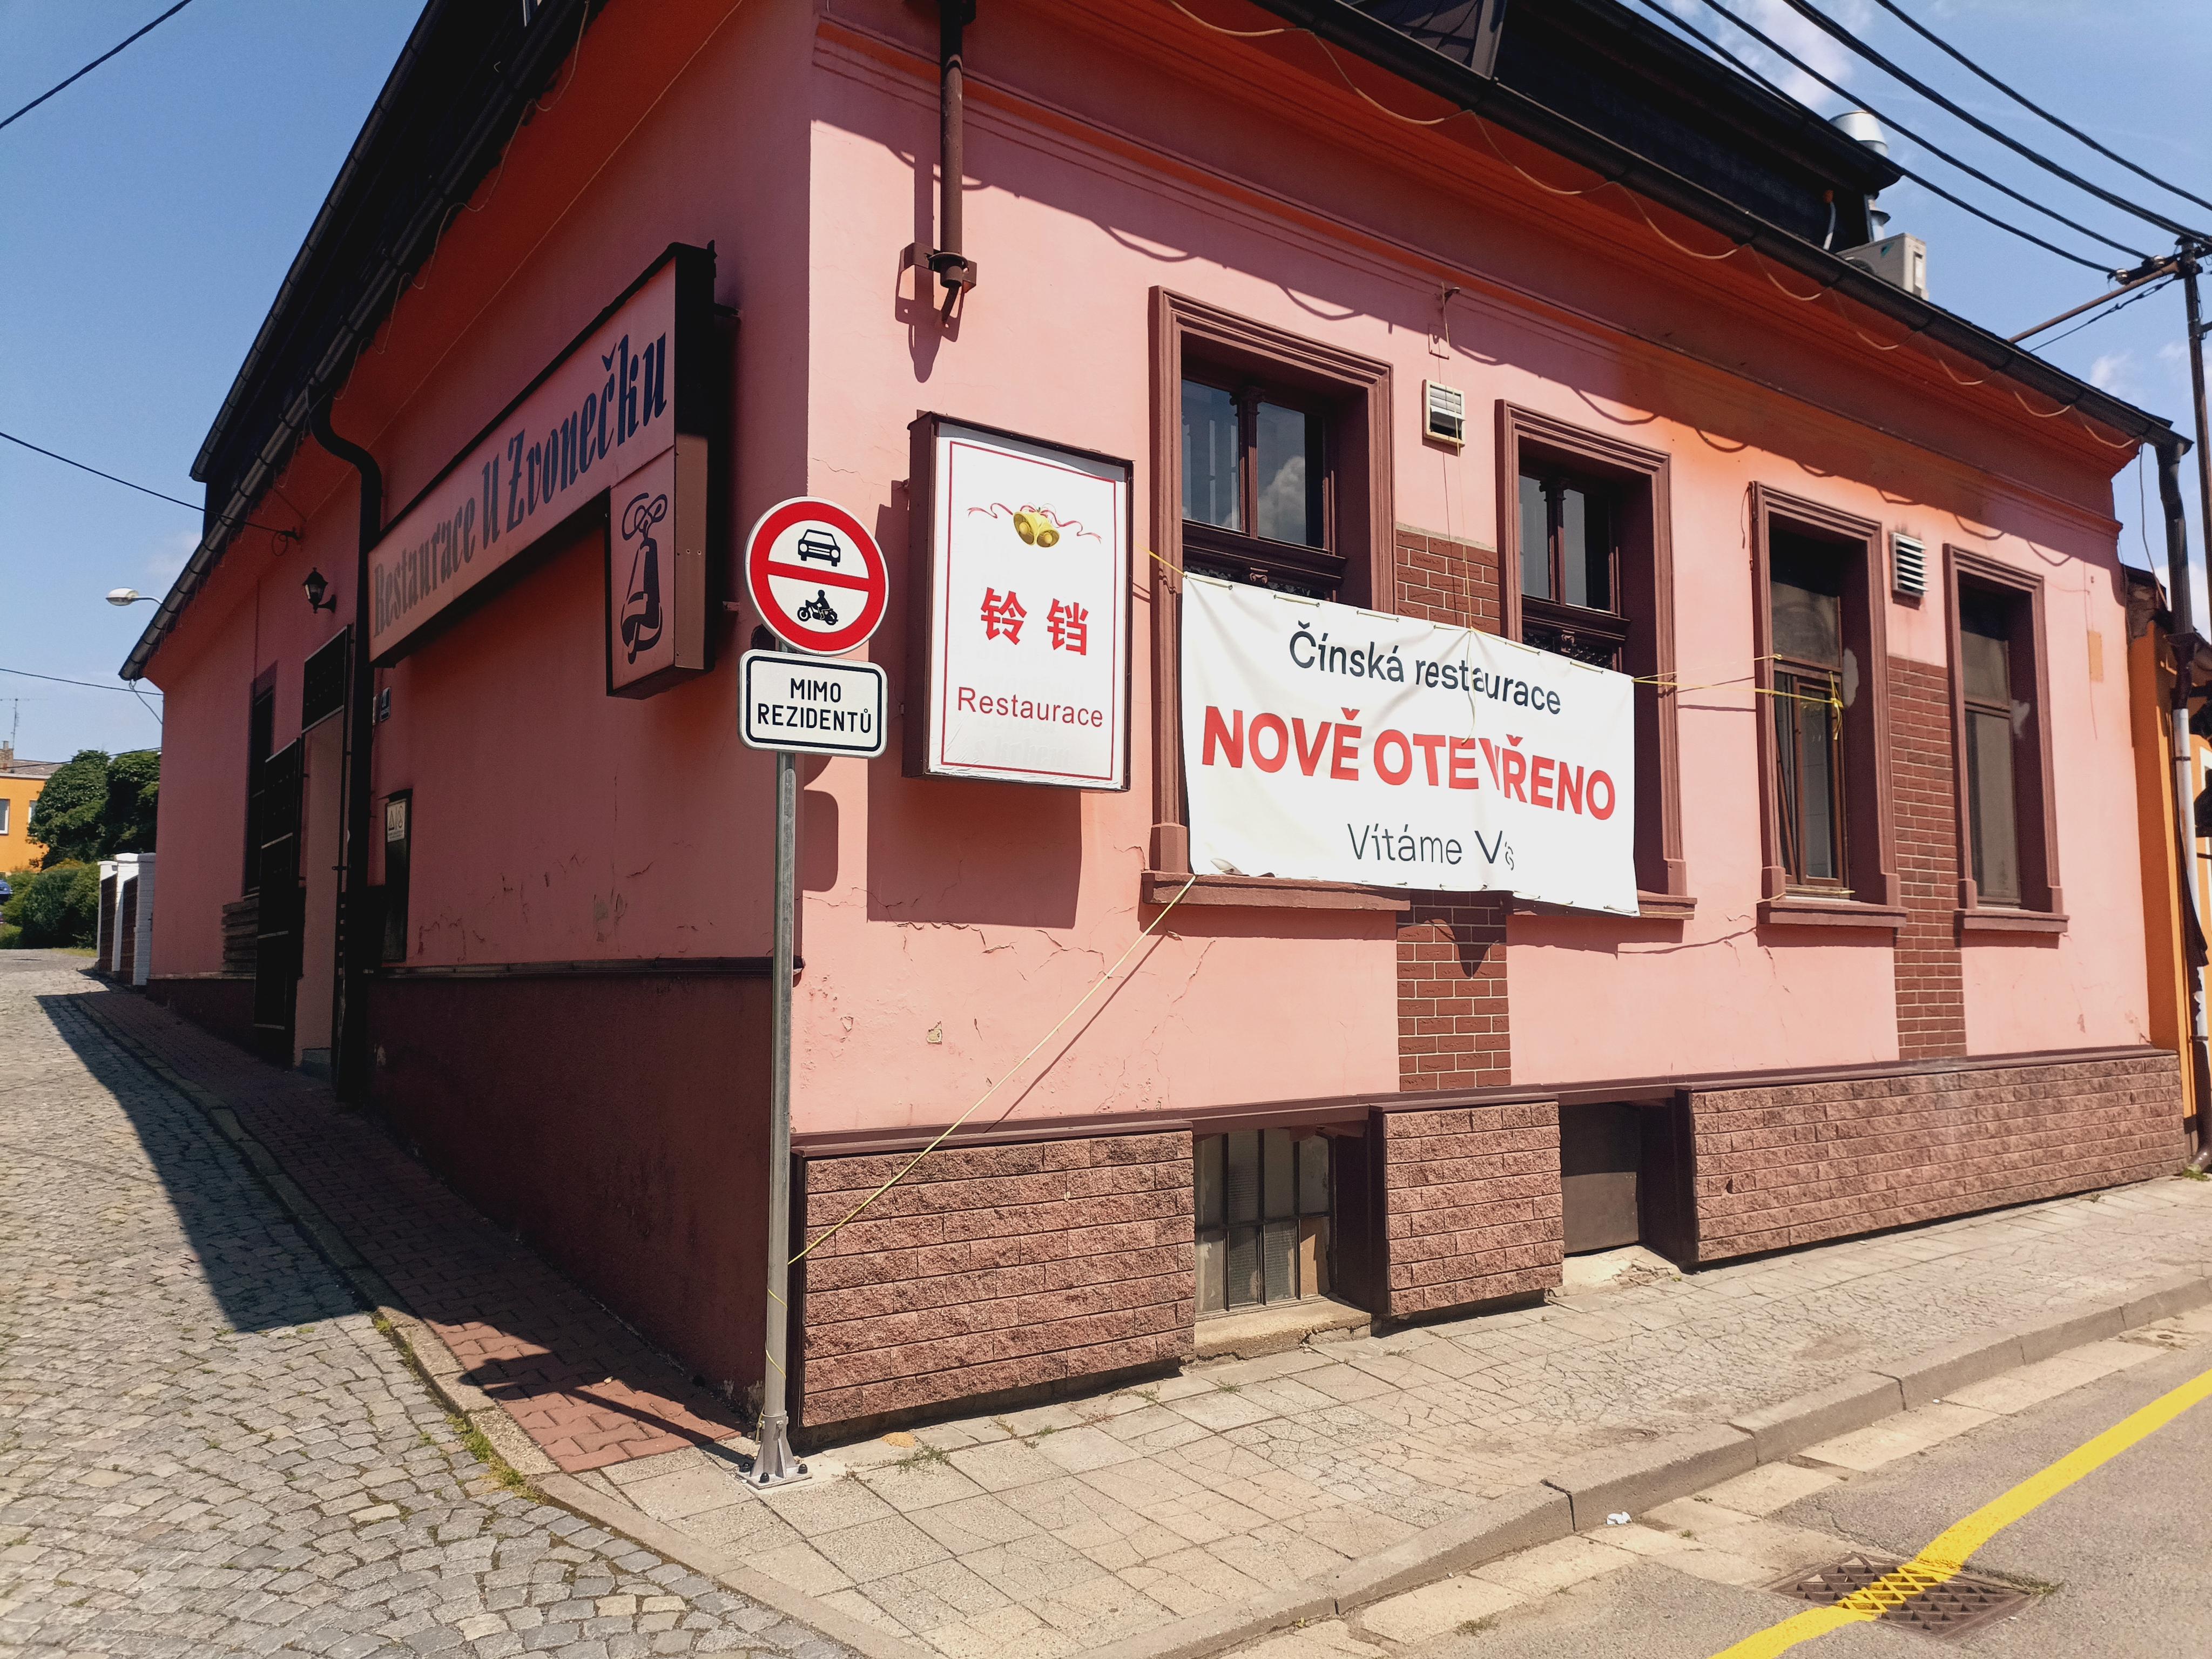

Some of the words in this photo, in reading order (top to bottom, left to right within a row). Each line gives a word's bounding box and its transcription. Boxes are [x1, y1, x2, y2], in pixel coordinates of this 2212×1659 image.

[374, 497, 475, 638] Restaurace
[482, 453, 500, 550] U
[507, 332, 667, 533] Zvonečku
[980, 587, 1089, 656] 铃铛
[791, 678, 841, 703] MIMO
[1289, 620, 1404, 683] Čínská
[1415, 659, 1561, 715] restaurace
[758, 703, 871, 733] REZIDENTŮ
[958, 686, 1103, 727] Restaurace
[1202, 706, 1362, 781] NOVĚ
[1373, 730, 1616, 821] OTEVŘENO
[1347, 823, 1463, 866] Vítáme
